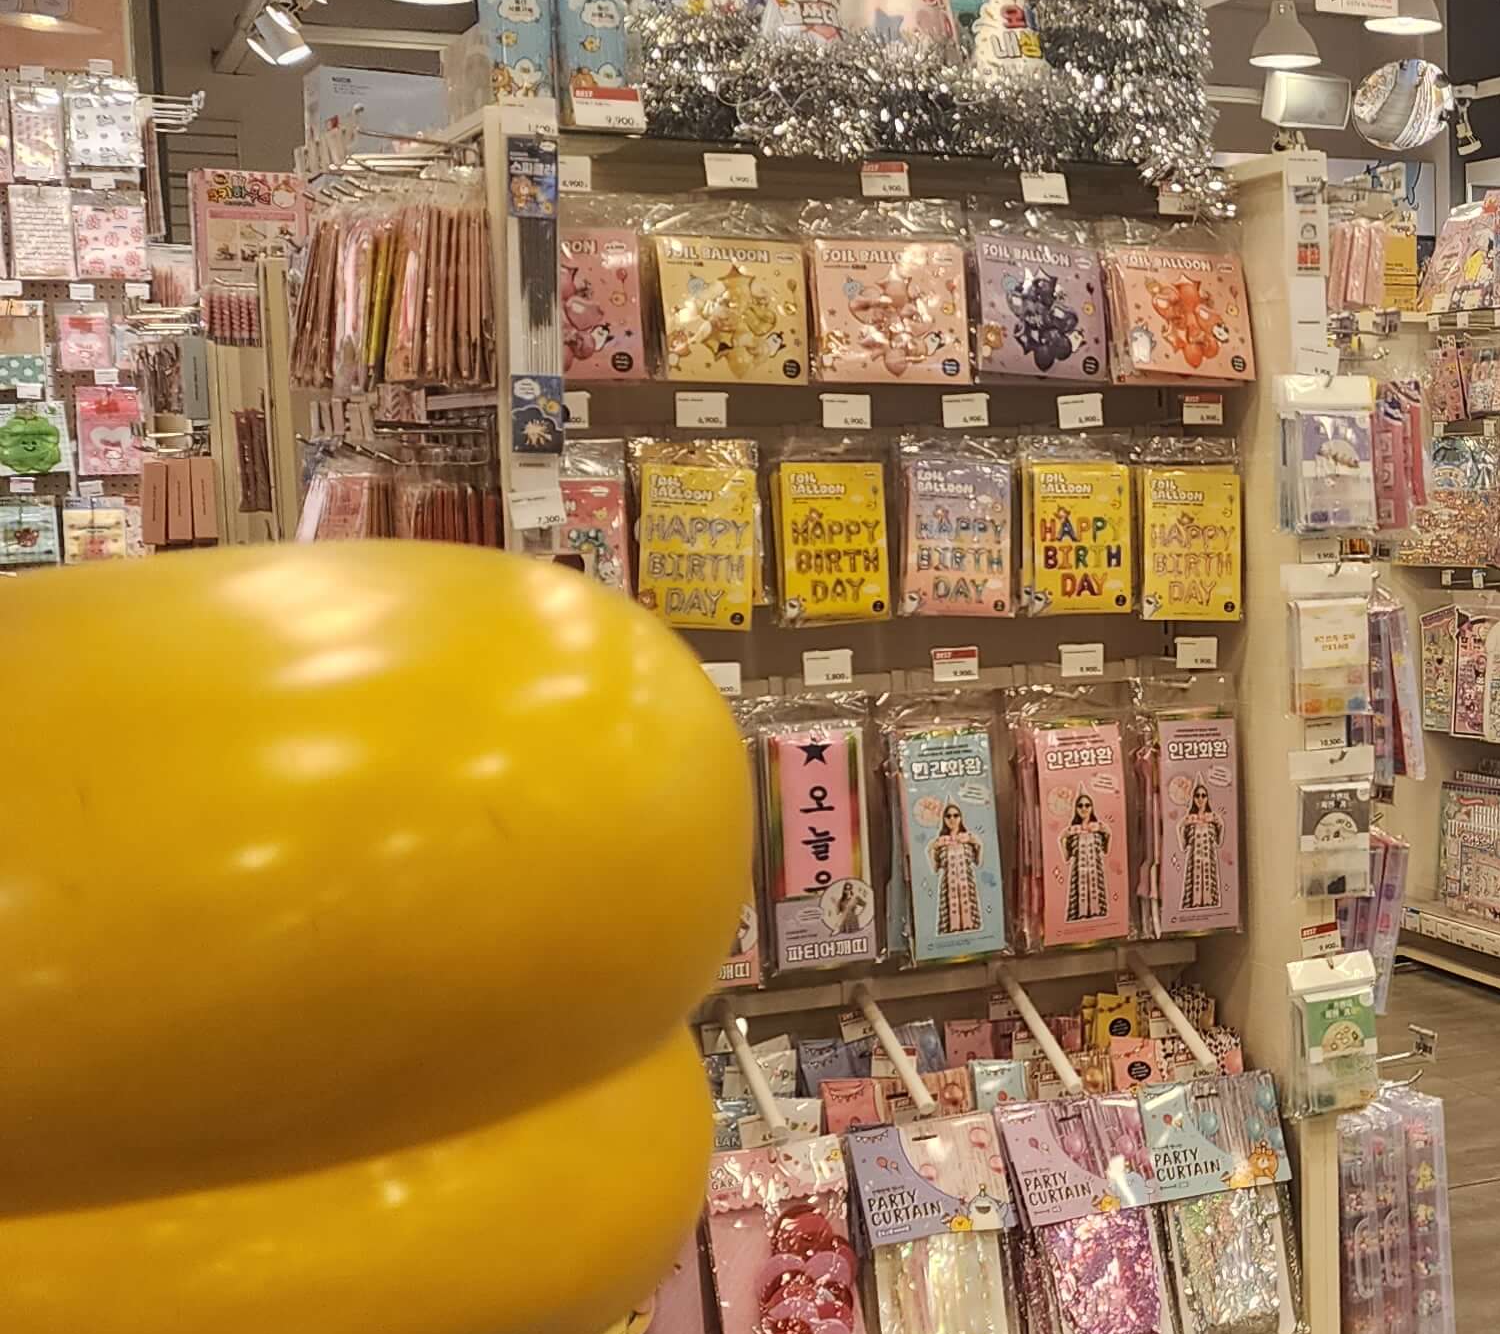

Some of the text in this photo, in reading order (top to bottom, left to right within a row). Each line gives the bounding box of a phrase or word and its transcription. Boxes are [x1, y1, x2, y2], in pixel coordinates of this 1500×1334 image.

[702, 247, 771, 264] BALLOON
[822, 247, 857, 262] FOIL
[982, 242, 1071, 267] FOIL BALLOON
[651, 473, 682, 488] FOIL
[790, 472, 818, 485] FOIL
[916, 469, 945, 483] FOIL
[916, 480, 974, 495] BALLOON
[1039, 472, 1066, 484] FOIL
[1039, 482, 1093, 495] BALLOON
[1151, 478, 1177, 491] FOIL
[651, 485, 714, 502] BALLOON
[790, 482, 847, 496] BALLOON
[1151, 488, 1205, 503] BALLOON
[646, 514, 750, 549] HAPPY
[790, 518, 881, 546] HAPPY
[915, 516, 1008, 543] HAPPY
[1039, 516, 1125, 543] HAPPY
[1150, 522, 1236, 550] HAPPY
[650, 551, 746, 584] BIRTH
[794, 548, 880, 576] BIRTH
[916, 546, 1004, 574] BIRTH
[1043, 544, 1122, 571] BIRTH
[1152, 551, 1234, 576] BIRTH
[810, 578, 866, 604] DAY
[932, 576, 988, 605] DAY
[1059, 571, 1110, 598] DAY
[1167, 580, 1218, 607] DAY
[663, 587, 726, 619] DAY
[1046, 746, 1114, 772] 인간화환
[1167, 738, 1230, 762] 인간화환
[911, 756, 983, 782] 인간화환
[786, 936, 869, 963] 파티어깨띠
[1152, 1146, 1200, 1168] PARTY
[1023, 1170, 1068, 1193] PARTY
[1156, 1159, 1221, 1183] CURTAIN
[867, 1189, 918, 1213] PARTY
[1027, 1181, 1092, 1207] CURTAIN
[871, 1200, 943, 1227] CURTAIN
